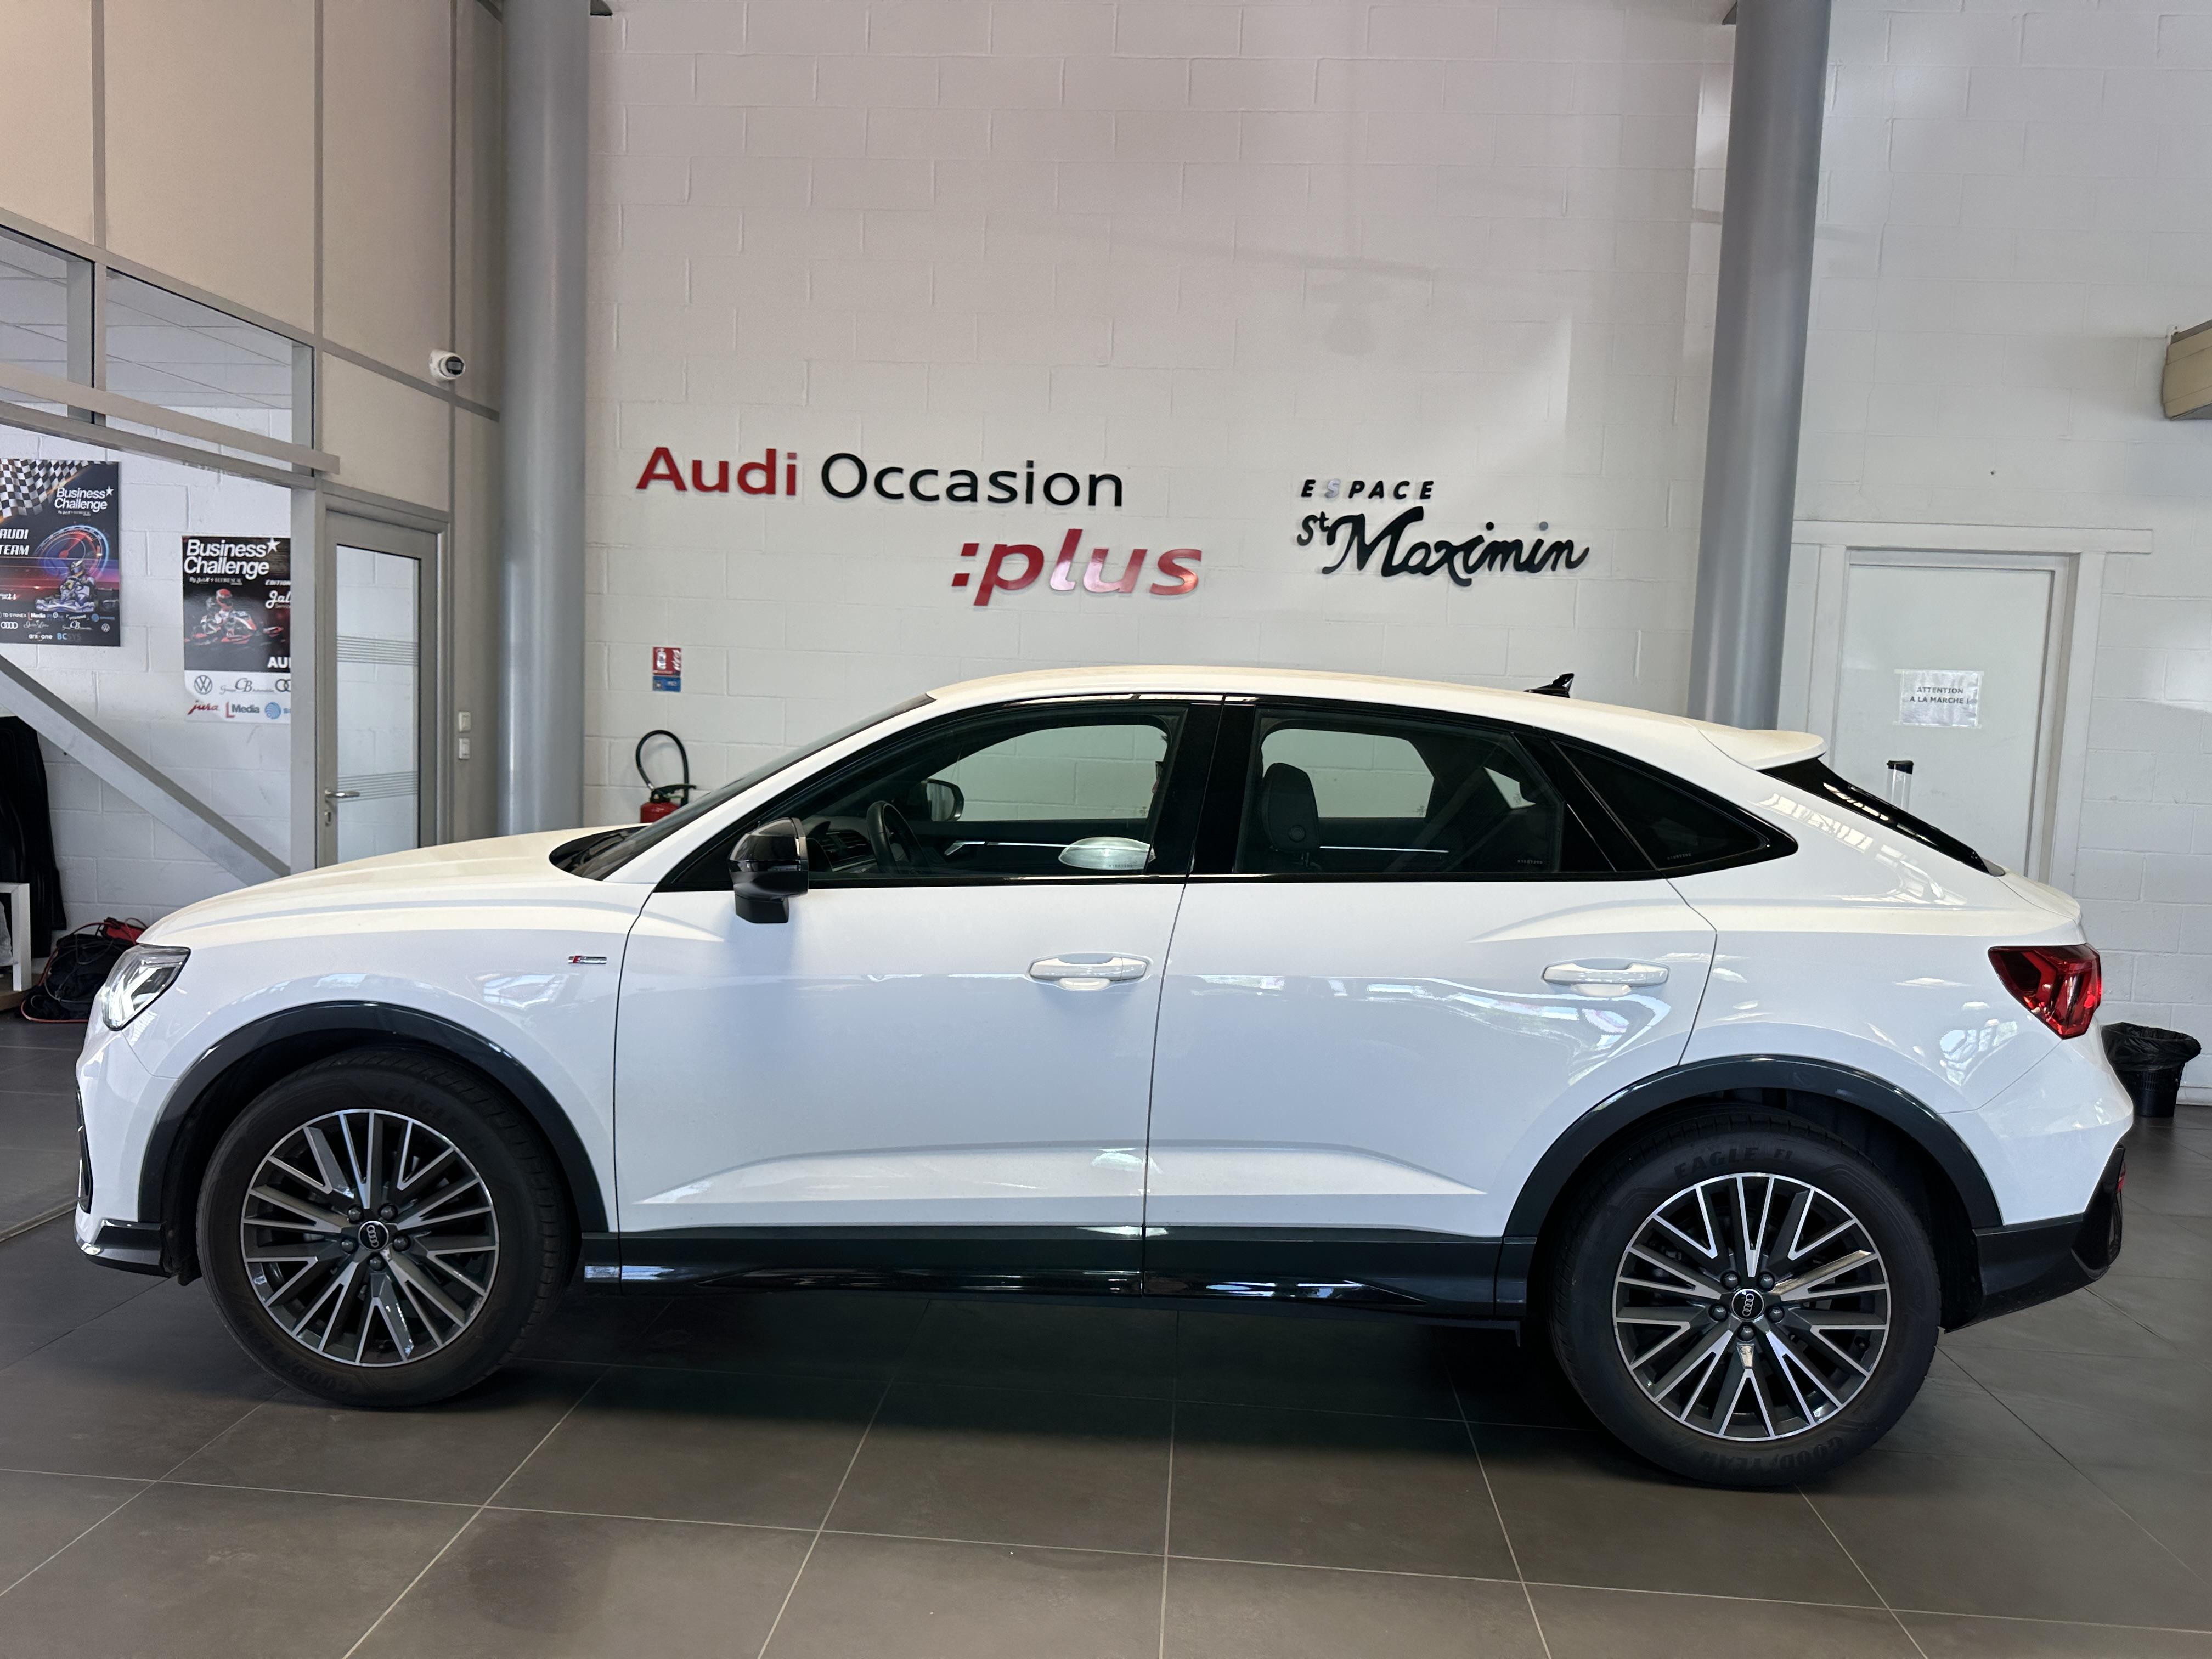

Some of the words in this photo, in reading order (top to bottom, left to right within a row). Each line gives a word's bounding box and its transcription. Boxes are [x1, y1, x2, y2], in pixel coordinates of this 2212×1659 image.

[636, 447, 797, 496] Audi
[821, 453, 1122, 507] Occasion
[56, 487, 106, 499] Business
[1301, 479, 1434, 500] ESPACE
[54, 498, 108, 513] Challenge
[0, 528, 29, 539] AUDI
[187, 539, 267, 558] Business
[1322, 506, 1590, 587] Maximin
[184, 556, 270, 580] Challenge
[1674, 1147, 1759, 1180] EAGLE
